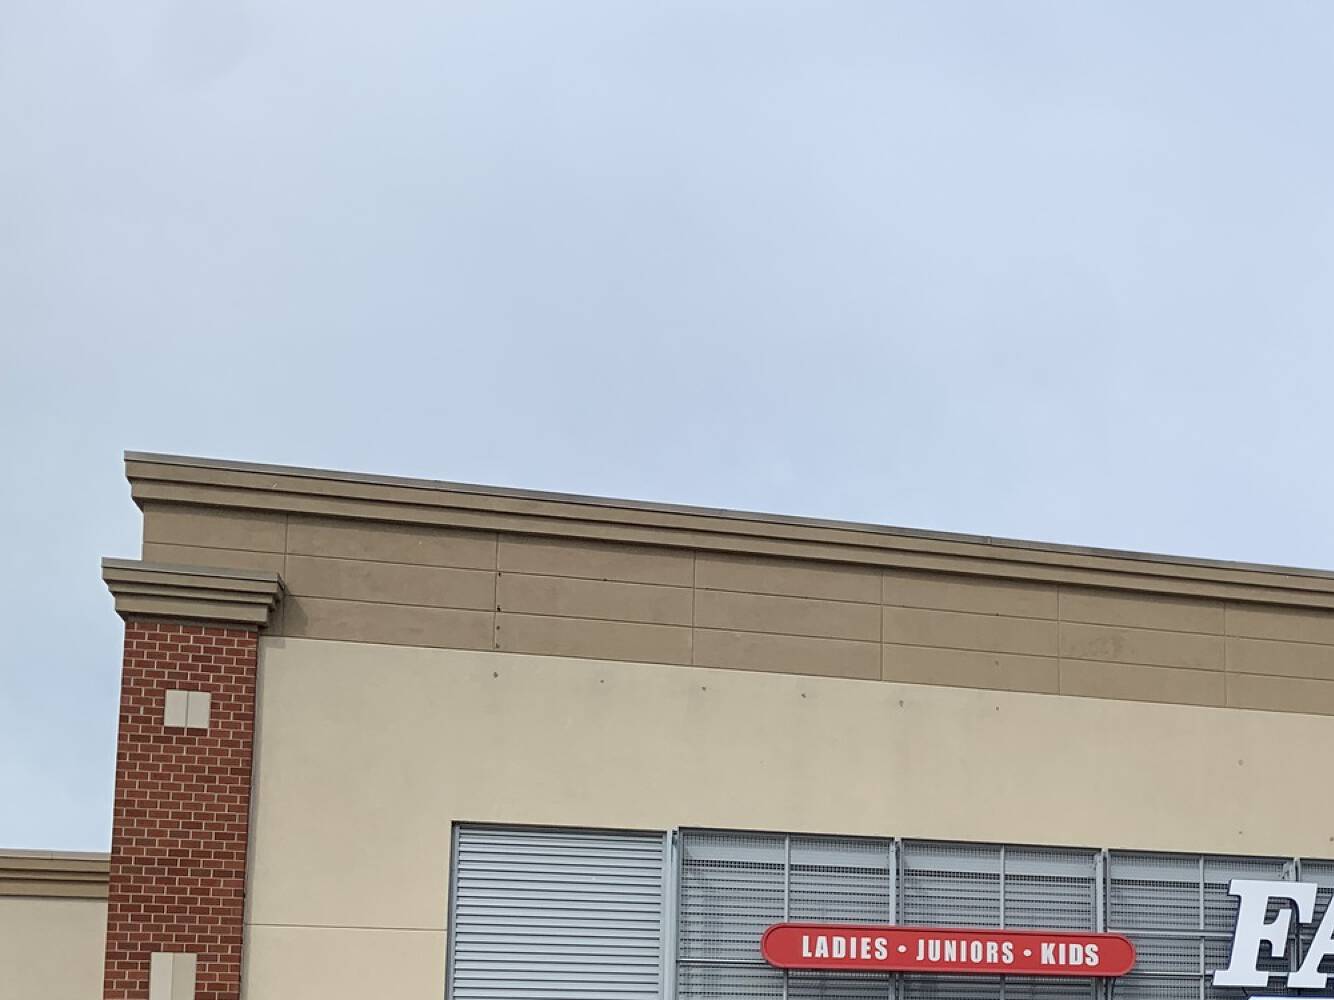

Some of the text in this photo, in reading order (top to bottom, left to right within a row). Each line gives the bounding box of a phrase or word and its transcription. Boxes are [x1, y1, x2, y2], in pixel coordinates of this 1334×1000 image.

[802, 935, 1100, 966] LADIES JUNIORS KIDS
